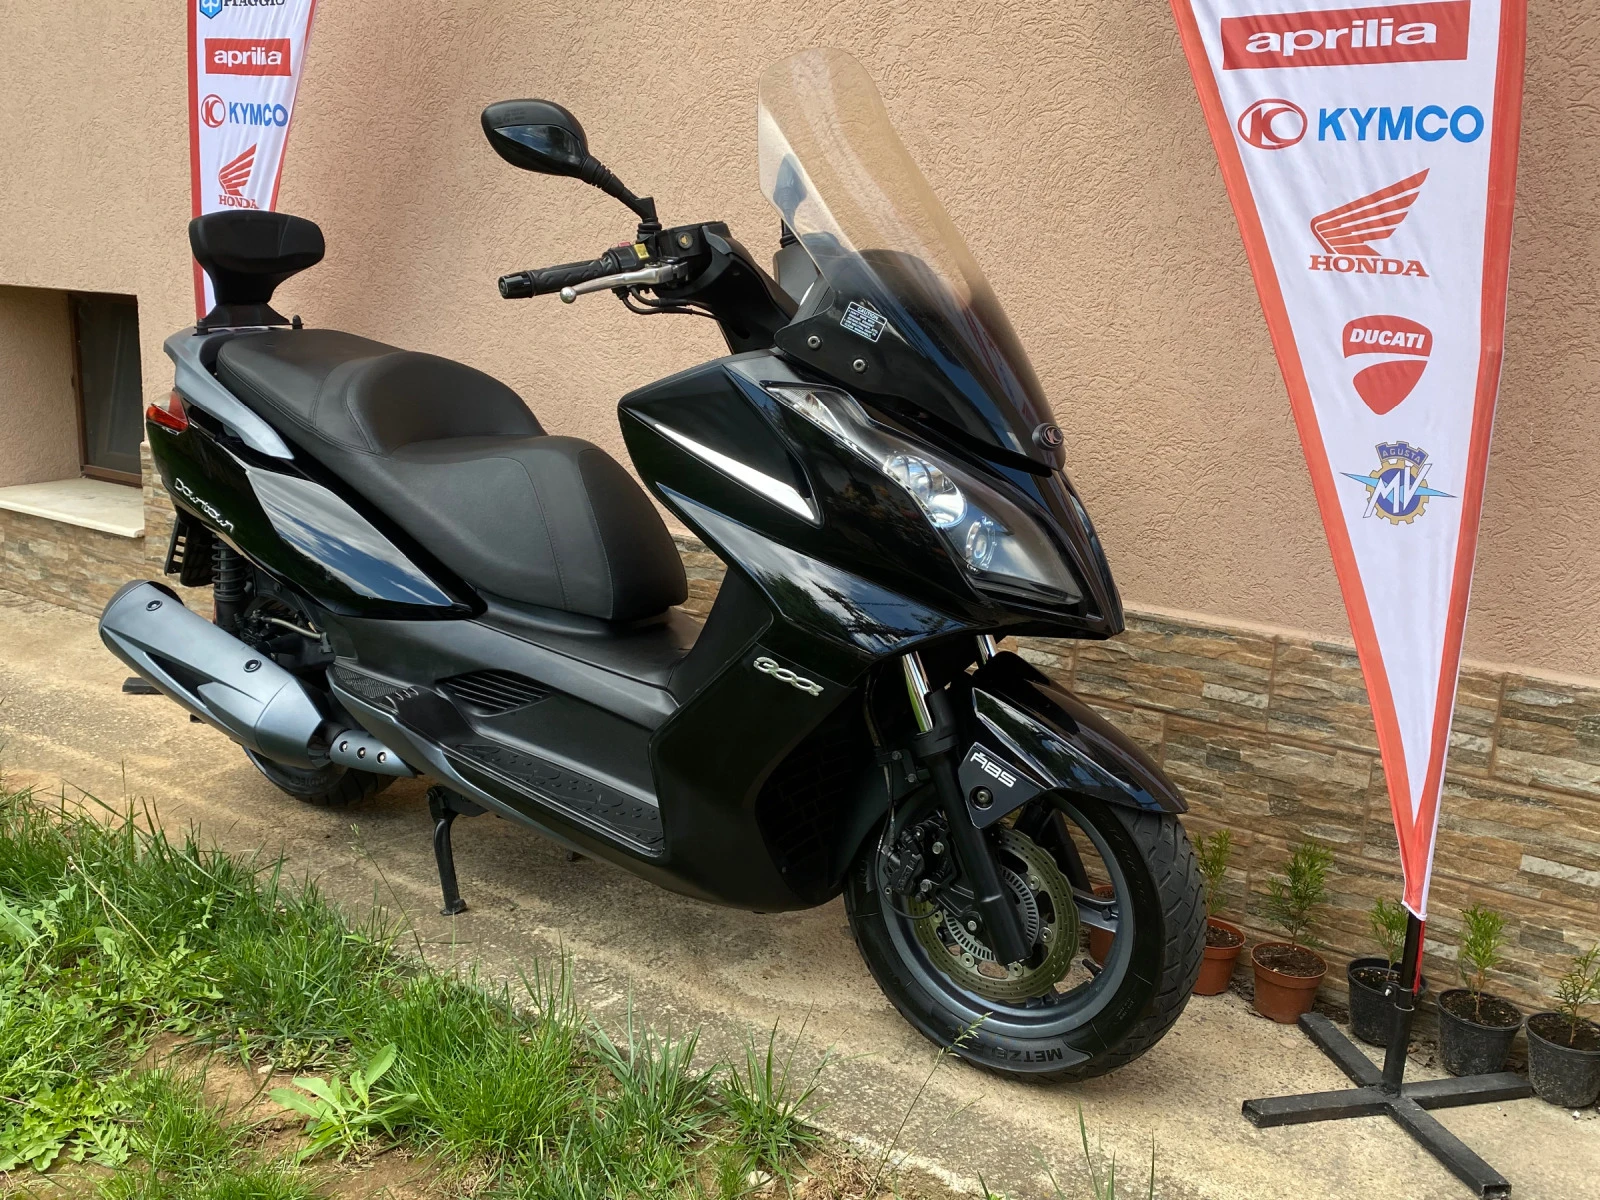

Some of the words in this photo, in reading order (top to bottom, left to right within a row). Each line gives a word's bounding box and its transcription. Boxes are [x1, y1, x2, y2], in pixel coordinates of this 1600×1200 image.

[1245, 18, 1437, 57] aprilia
[213, 47, 282, 67] aprilia
[229, 102, 288, 127] KYMCO
[1318, 105, 1484, 143] KYMCO
[218, 195, 260, 209] HONDA
[1309, 254, 1429, 278] HONDA
[1350, 328, 1425, 349] DUCATI
[1382, 448, 1421, 463] AGUSTA
[1363, 463, 1433, 518] MV
[970, 752, 1017, 788] ABS
